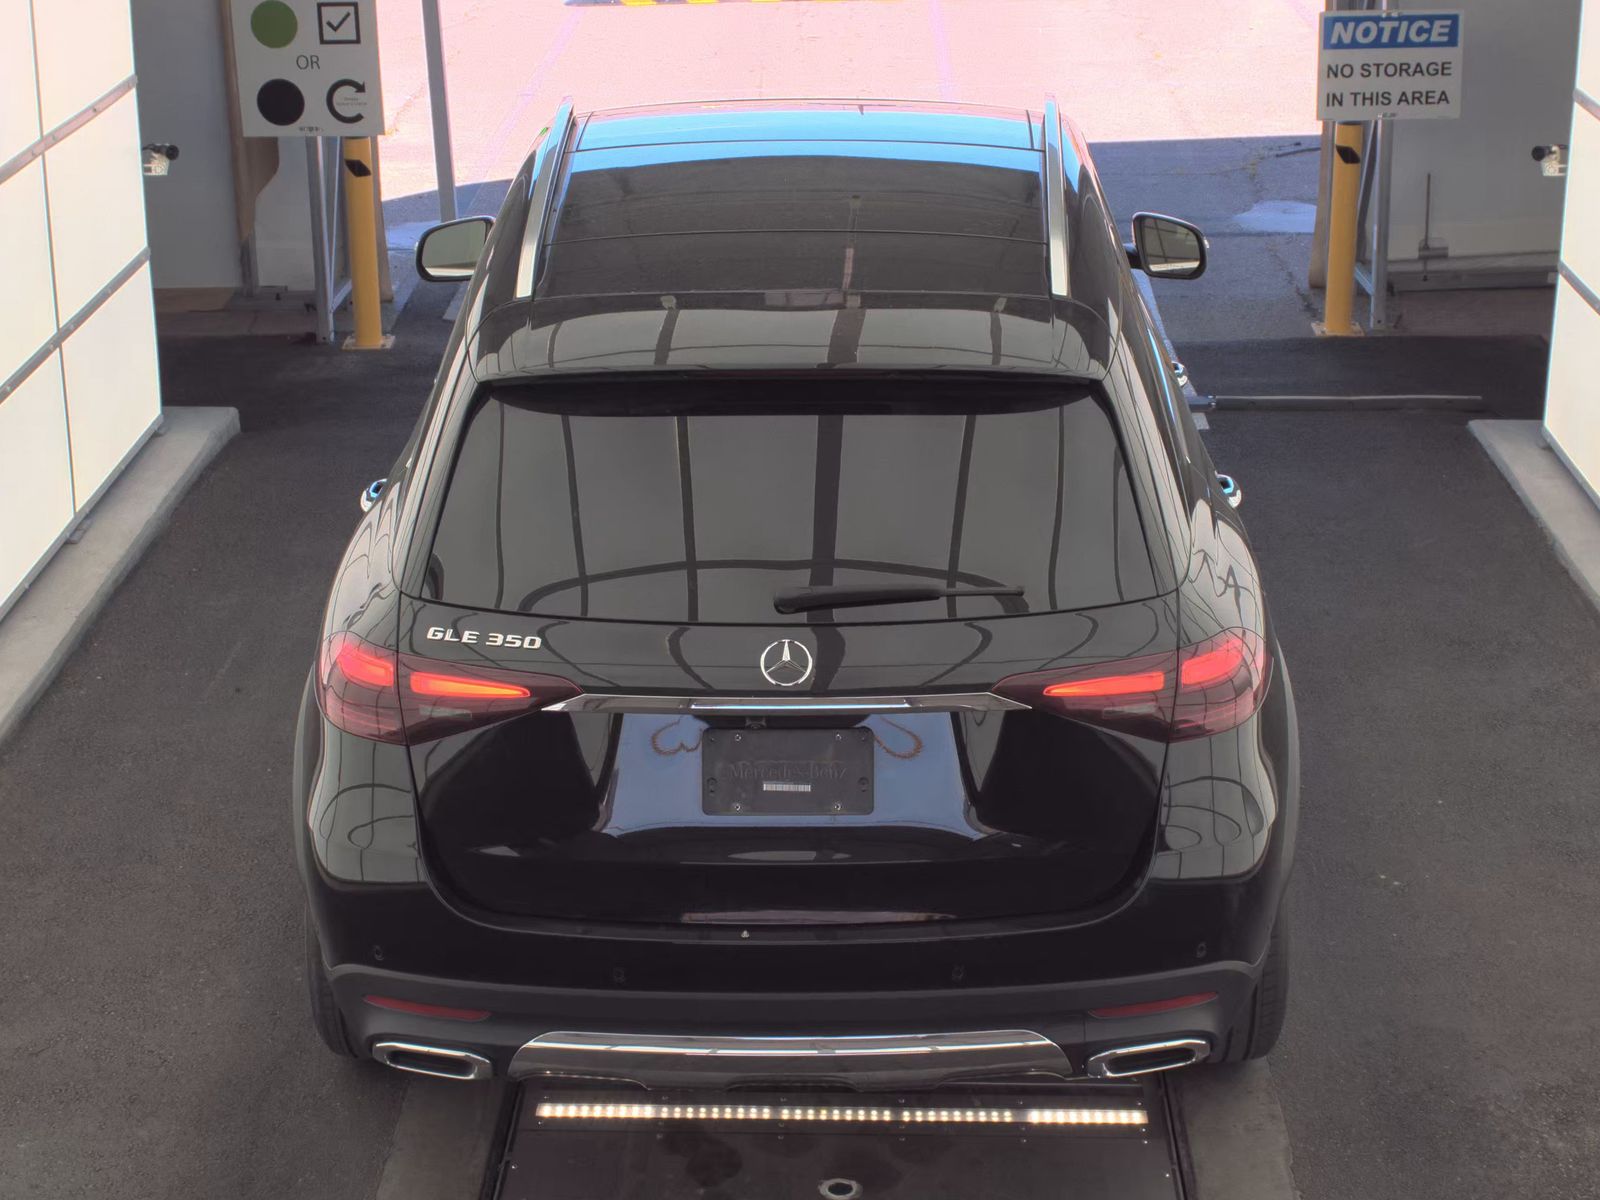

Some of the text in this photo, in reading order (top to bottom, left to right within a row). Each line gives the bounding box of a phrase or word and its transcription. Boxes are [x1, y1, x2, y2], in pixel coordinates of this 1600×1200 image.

[1330, 19, 1453, 45] NOTICE
[295, 54, 321, 70] OR
[1326, 61, 1453, 79] NO STORAGE
[1326, 90, 1450, 107] IN THIS AREA
[426, 626, 542, 649] GLE 350
